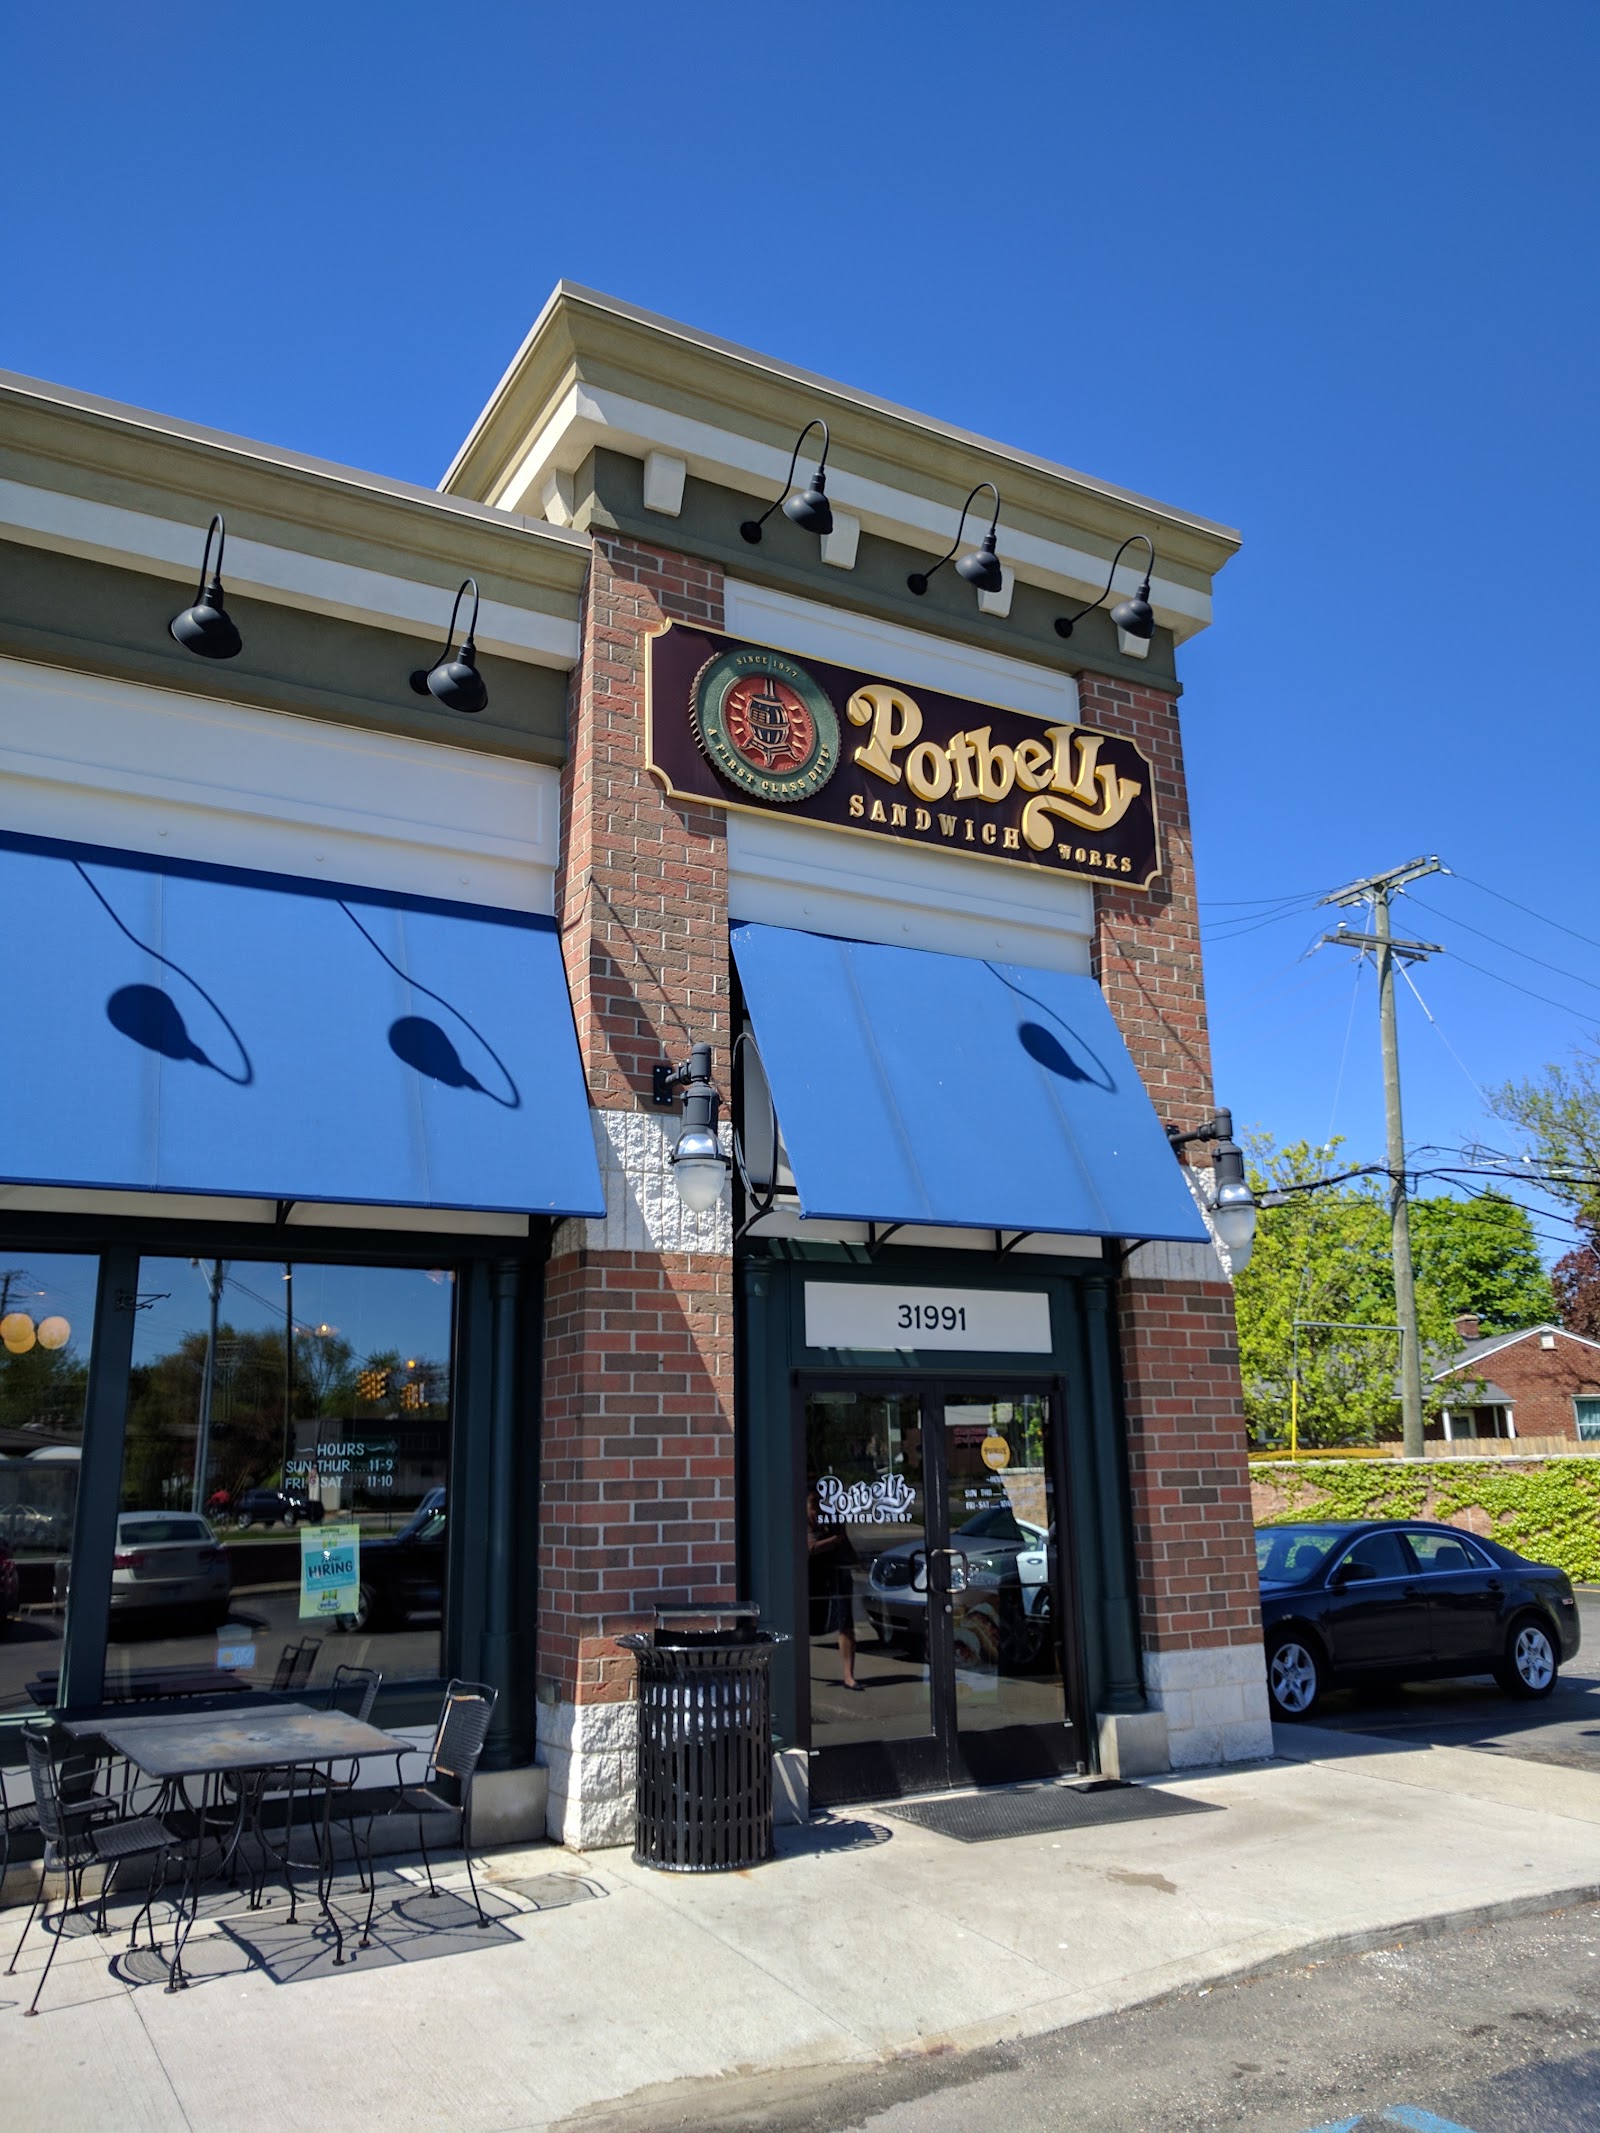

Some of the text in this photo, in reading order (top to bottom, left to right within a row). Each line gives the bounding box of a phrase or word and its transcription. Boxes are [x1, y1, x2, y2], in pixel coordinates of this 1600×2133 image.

[736, 655, 798, 678] SINCE 1977
[707, 728, 717, 736] A
[715, 744, 755, 784] FIRST
[761, 779, 806, 793] CLASS
[846, 684, 1142, 851] Potbelly
[849, 795, 1133, 873] SANDWICH WORKS
[898, 1304, 966, 1331] 31991
[316, 1442, 365, 1456] HOURS
[816, 1472, 916, 1524] Potbelly
[817, 1512, 913, 1524] SANDWICH SHOP
[308, 1560, 353, 1578] HIRING
